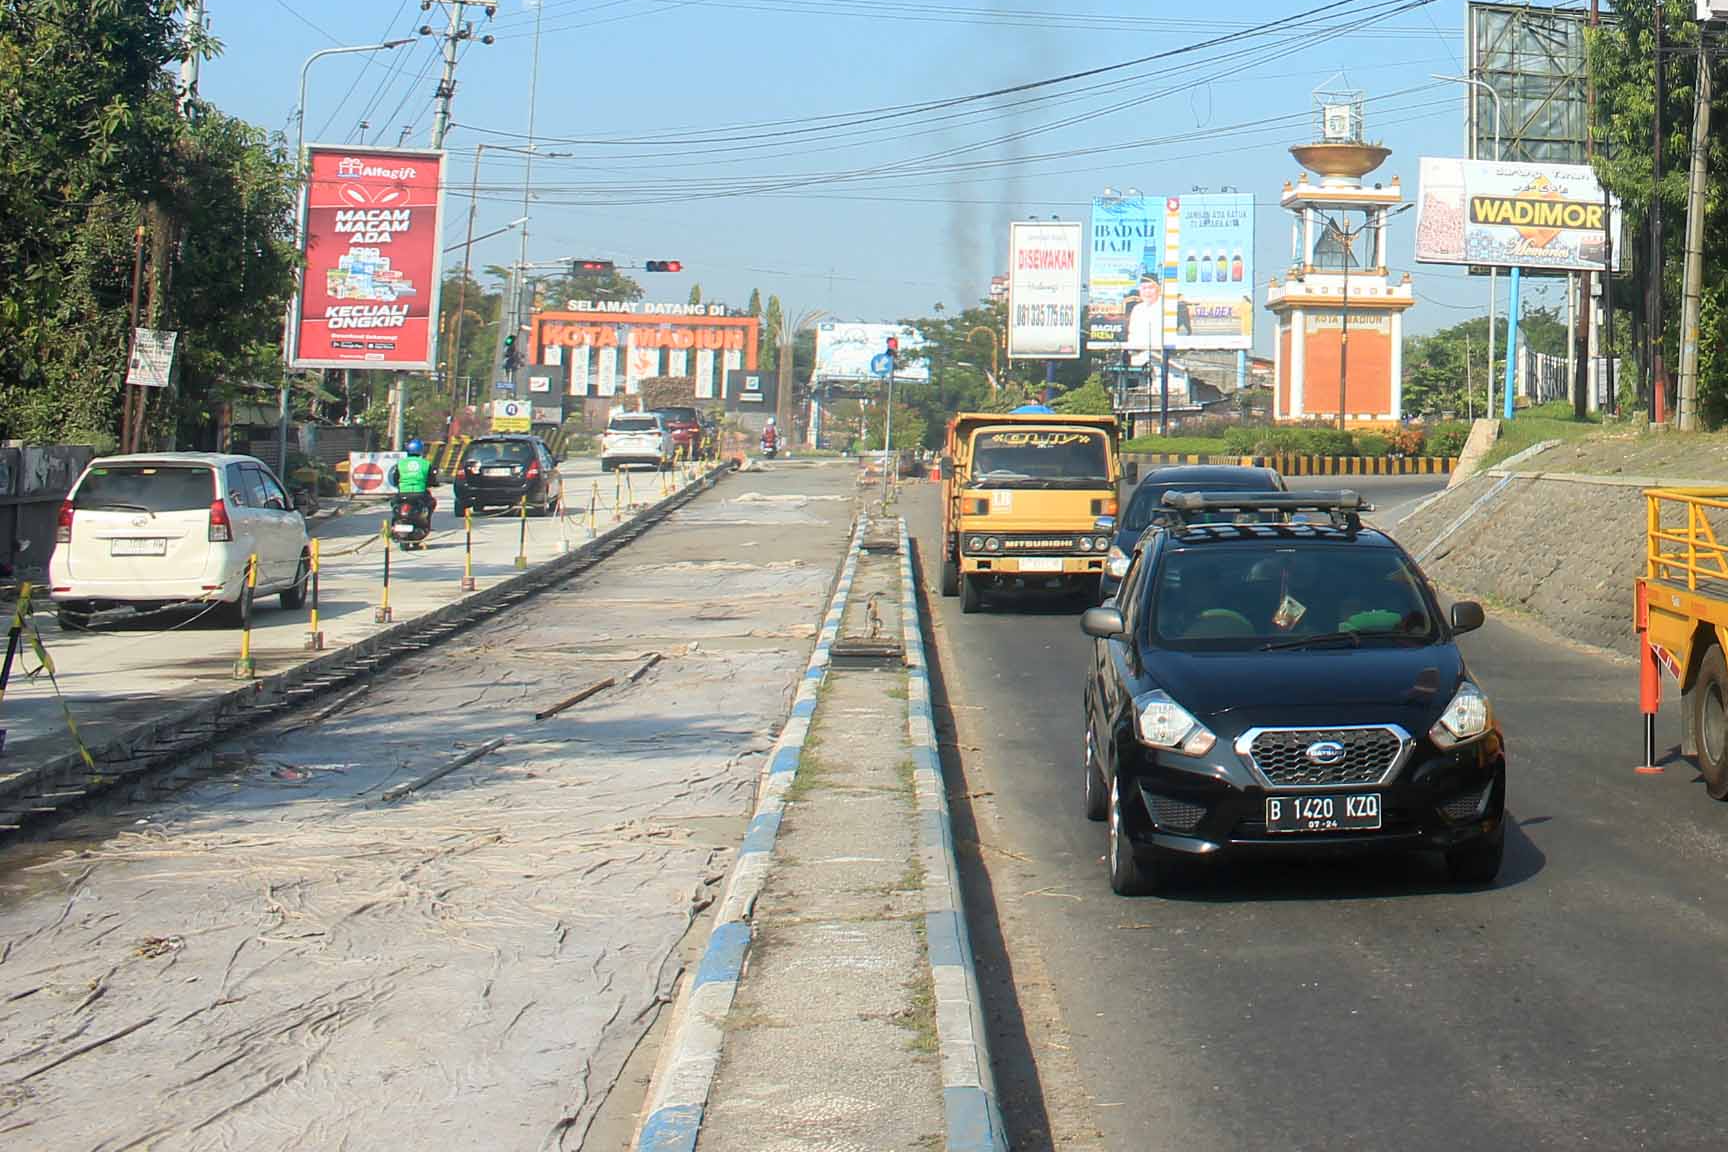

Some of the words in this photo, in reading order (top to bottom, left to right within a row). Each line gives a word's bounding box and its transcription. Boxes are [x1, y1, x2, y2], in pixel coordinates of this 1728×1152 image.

[362, 166, 417, 179] Alfagift
[335, 209, 411, 223] MACAM
[1473, 199, 1602, 228] WADIMOR
[334, 221, 410, 233] MACAM
[1094, 224, 1157, 238] IBADAH
[349, 232, 392, 244] ADA
[1094, 239, 1132, 252] HAJI
[1018, 249, 1075, 270] DISEWAKAN
[325, 304, 409, 318] KECUALI
[567, 300, 638, 314] SELAMAT
[644, 302, 705, 316] DATANG
[708, 305, 725, 317] DI
[327, 316, 405, 329] ONGKIR
[541, 325, 618, 347] KOTA
[630, 327, 744, 350] MADIUN
[1004, 540, 1073, 548] MITSUBISHI
[1271, 800, 1281, 821] B
[1293, 798, 1334, 820] 1420
